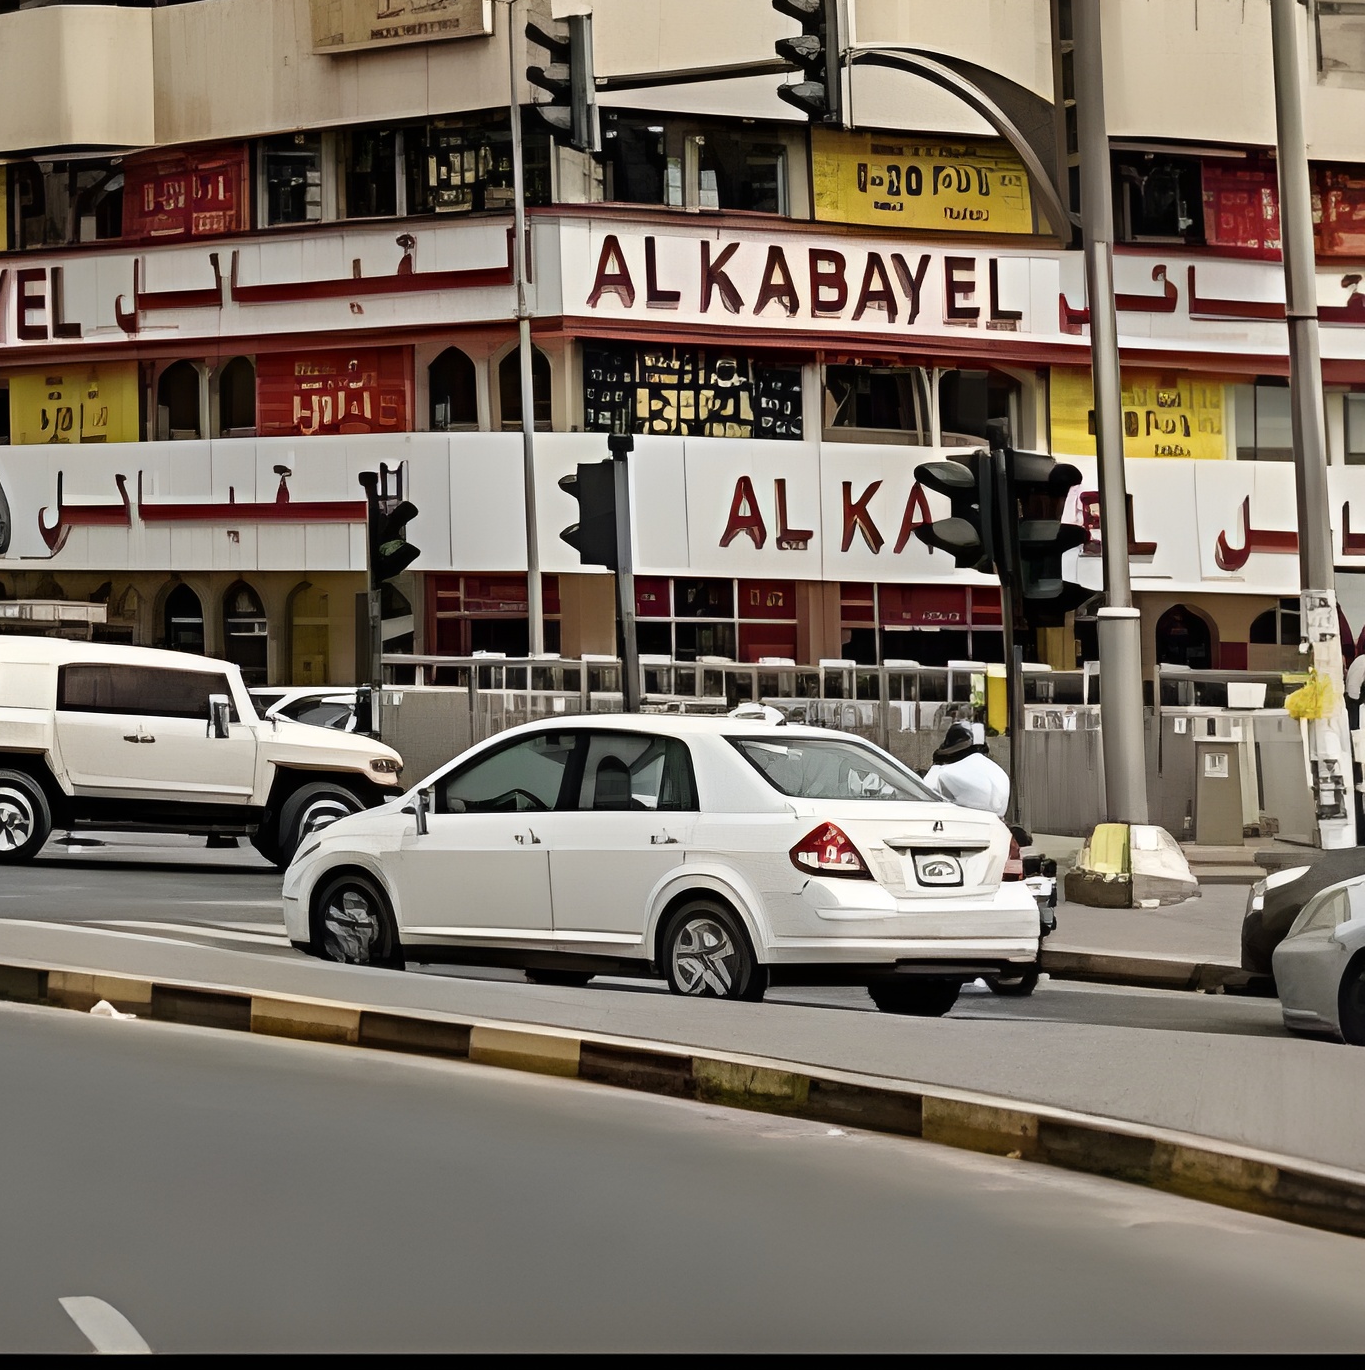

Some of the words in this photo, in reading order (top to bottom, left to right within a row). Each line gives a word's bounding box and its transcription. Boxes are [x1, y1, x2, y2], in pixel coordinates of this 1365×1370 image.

[586, 234, 682, 310] AL
[699, 239, 1023, 330] KABAYEL
[718, 475, 814, 551] AL
